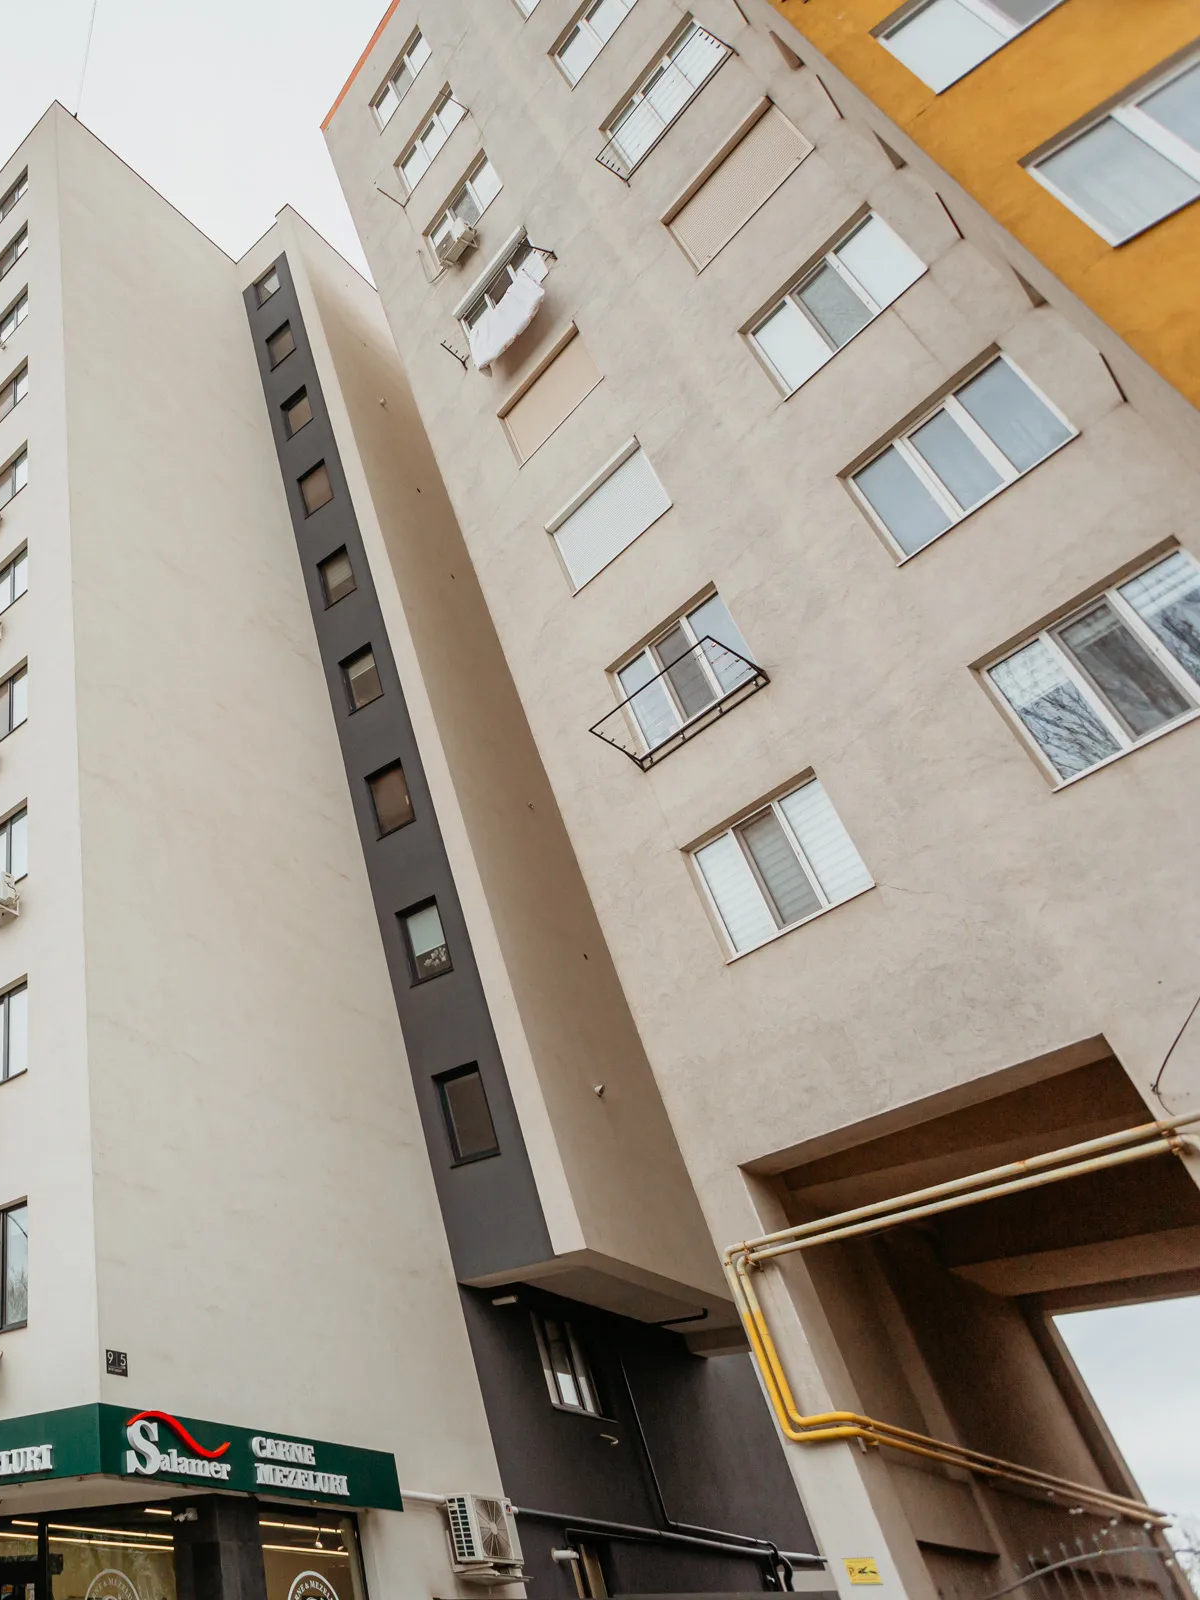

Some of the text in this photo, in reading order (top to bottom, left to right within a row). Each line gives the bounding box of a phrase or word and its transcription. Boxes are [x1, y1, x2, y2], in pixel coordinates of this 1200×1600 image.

[126, 1420, 232, 1480] Salamer
[252, 1436, 317, 1465] CARNE
[254, 1463, 350, 1495] MEZELURI
